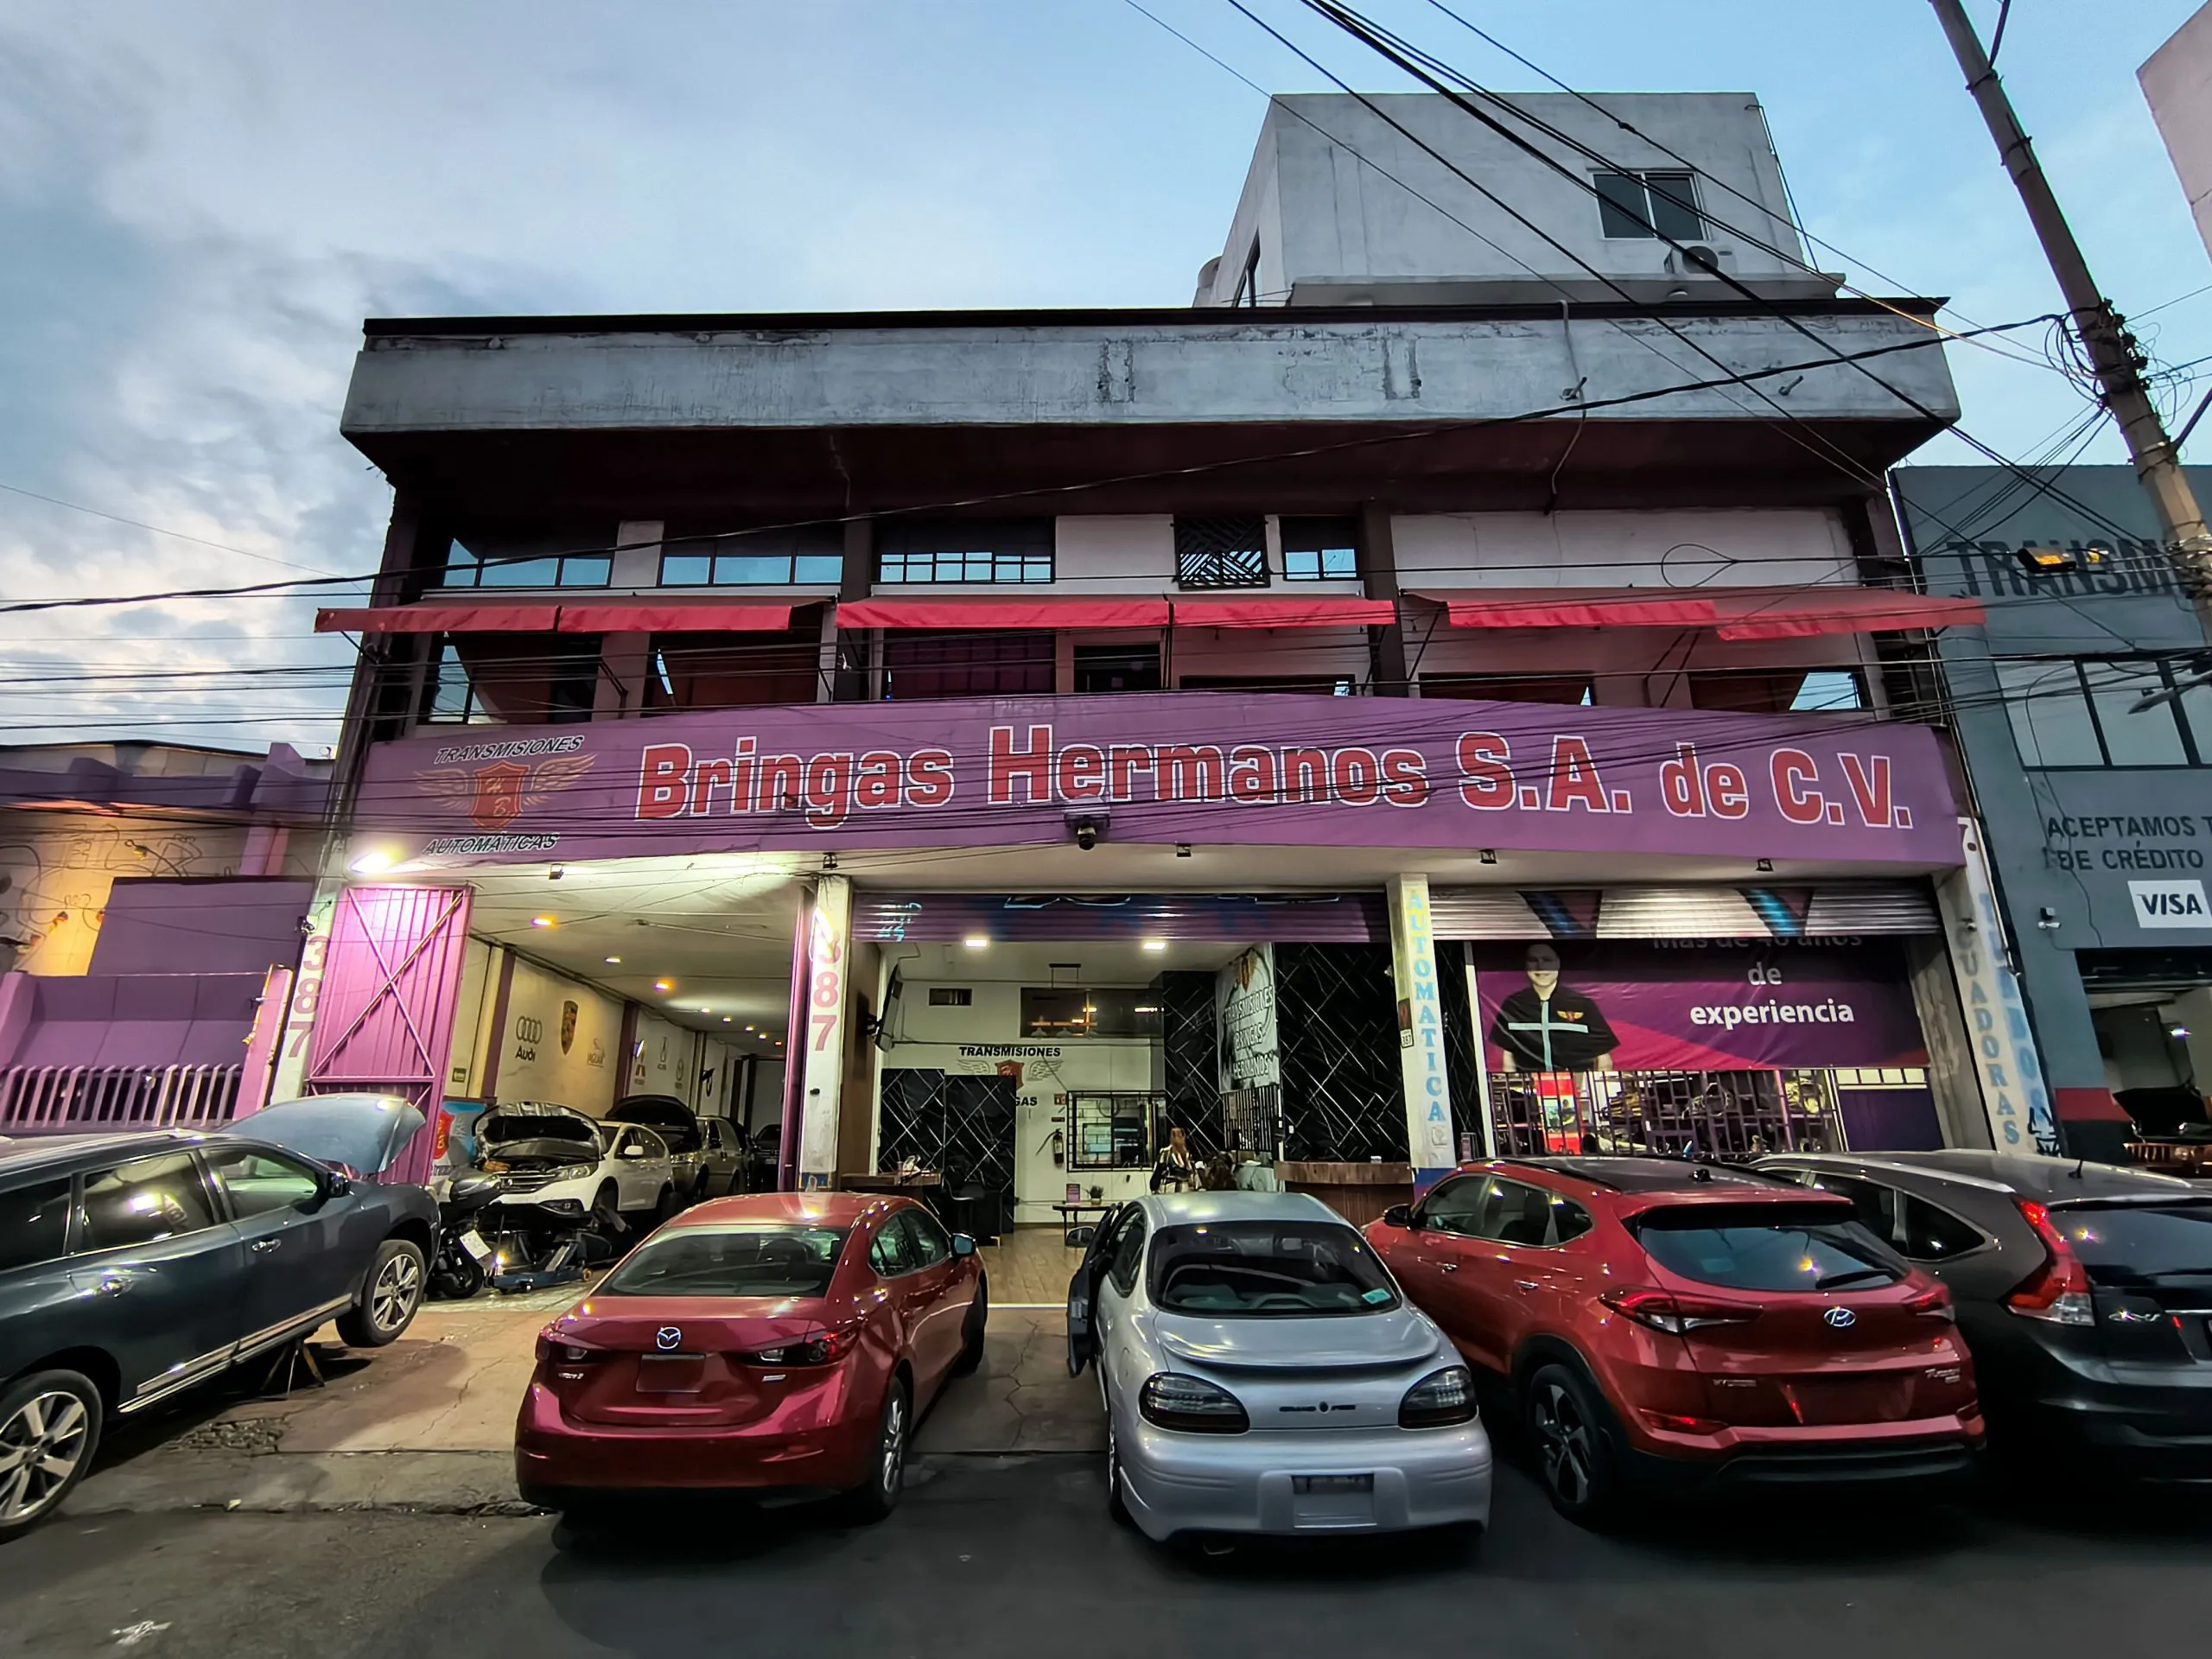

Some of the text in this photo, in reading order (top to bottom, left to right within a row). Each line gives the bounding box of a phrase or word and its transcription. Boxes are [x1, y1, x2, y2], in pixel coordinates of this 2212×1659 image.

[434, 735, 584, 765] TRANSMISIONES
[635, 723, 1914, 831] Bringas Hermanos S.A. de C.V.
[2047, 815, 2196, 838] ACEPTAMOS
[2057, 840, 2204, 871] DE CRÉDITO
[2139, 893, 2203, 916] VISA
[1747, 961, 1783, 986] de
[288, 935, 330, 1058] 387
[1407, 890, 1446, 1122] AUTOMATICA
[1689, 998, 1855, 1031] experiencia
[515, 1046, 537, 1063] Audi
[958, 1046, 1062, 1057] TRANSMISIONES
